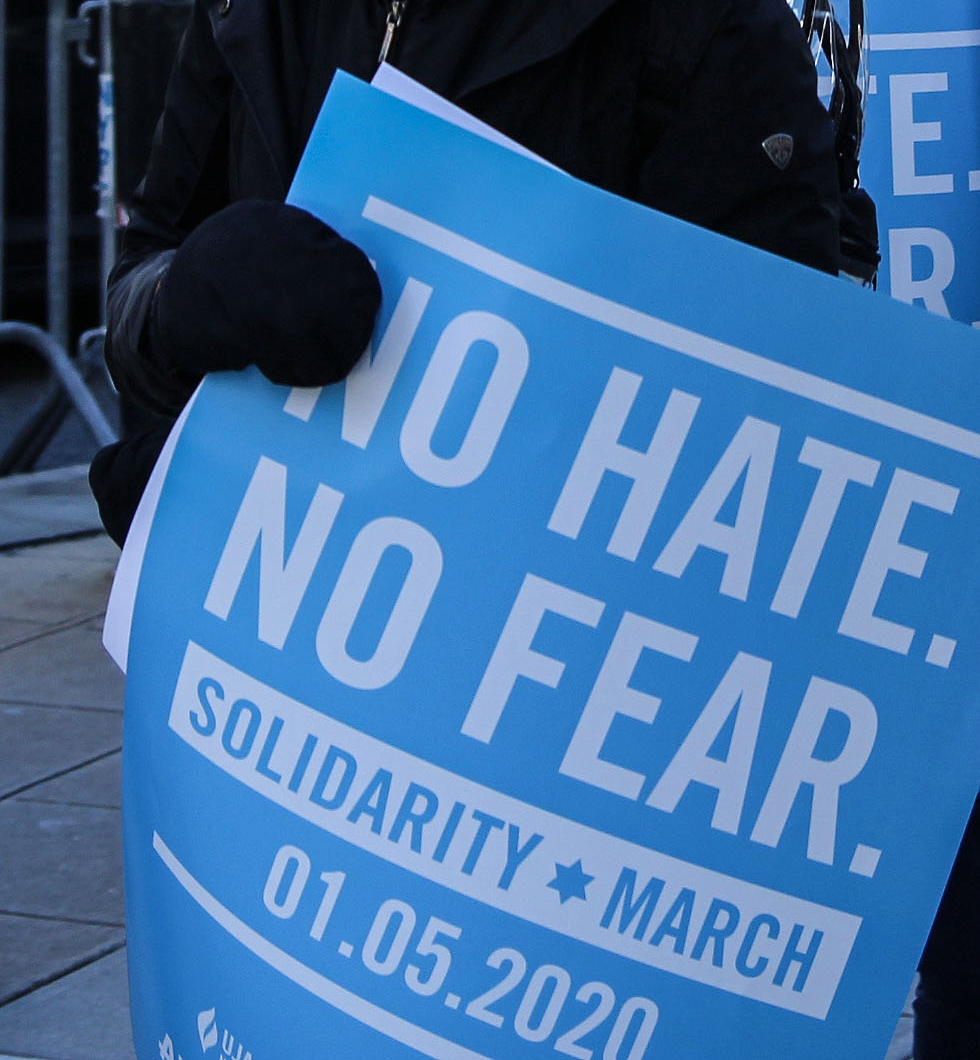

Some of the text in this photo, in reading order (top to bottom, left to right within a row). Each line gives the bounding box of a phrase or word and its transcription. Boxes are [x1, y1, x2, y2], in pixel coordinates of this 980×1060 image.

[283, 259, 961, 669] NO HATE.
[188, 677, 825, 994] SOLIDARITY MARCH
[203, 455, 882, 878] NO FEAR.
[263, 844, 660, 1060] 01.05.2020
